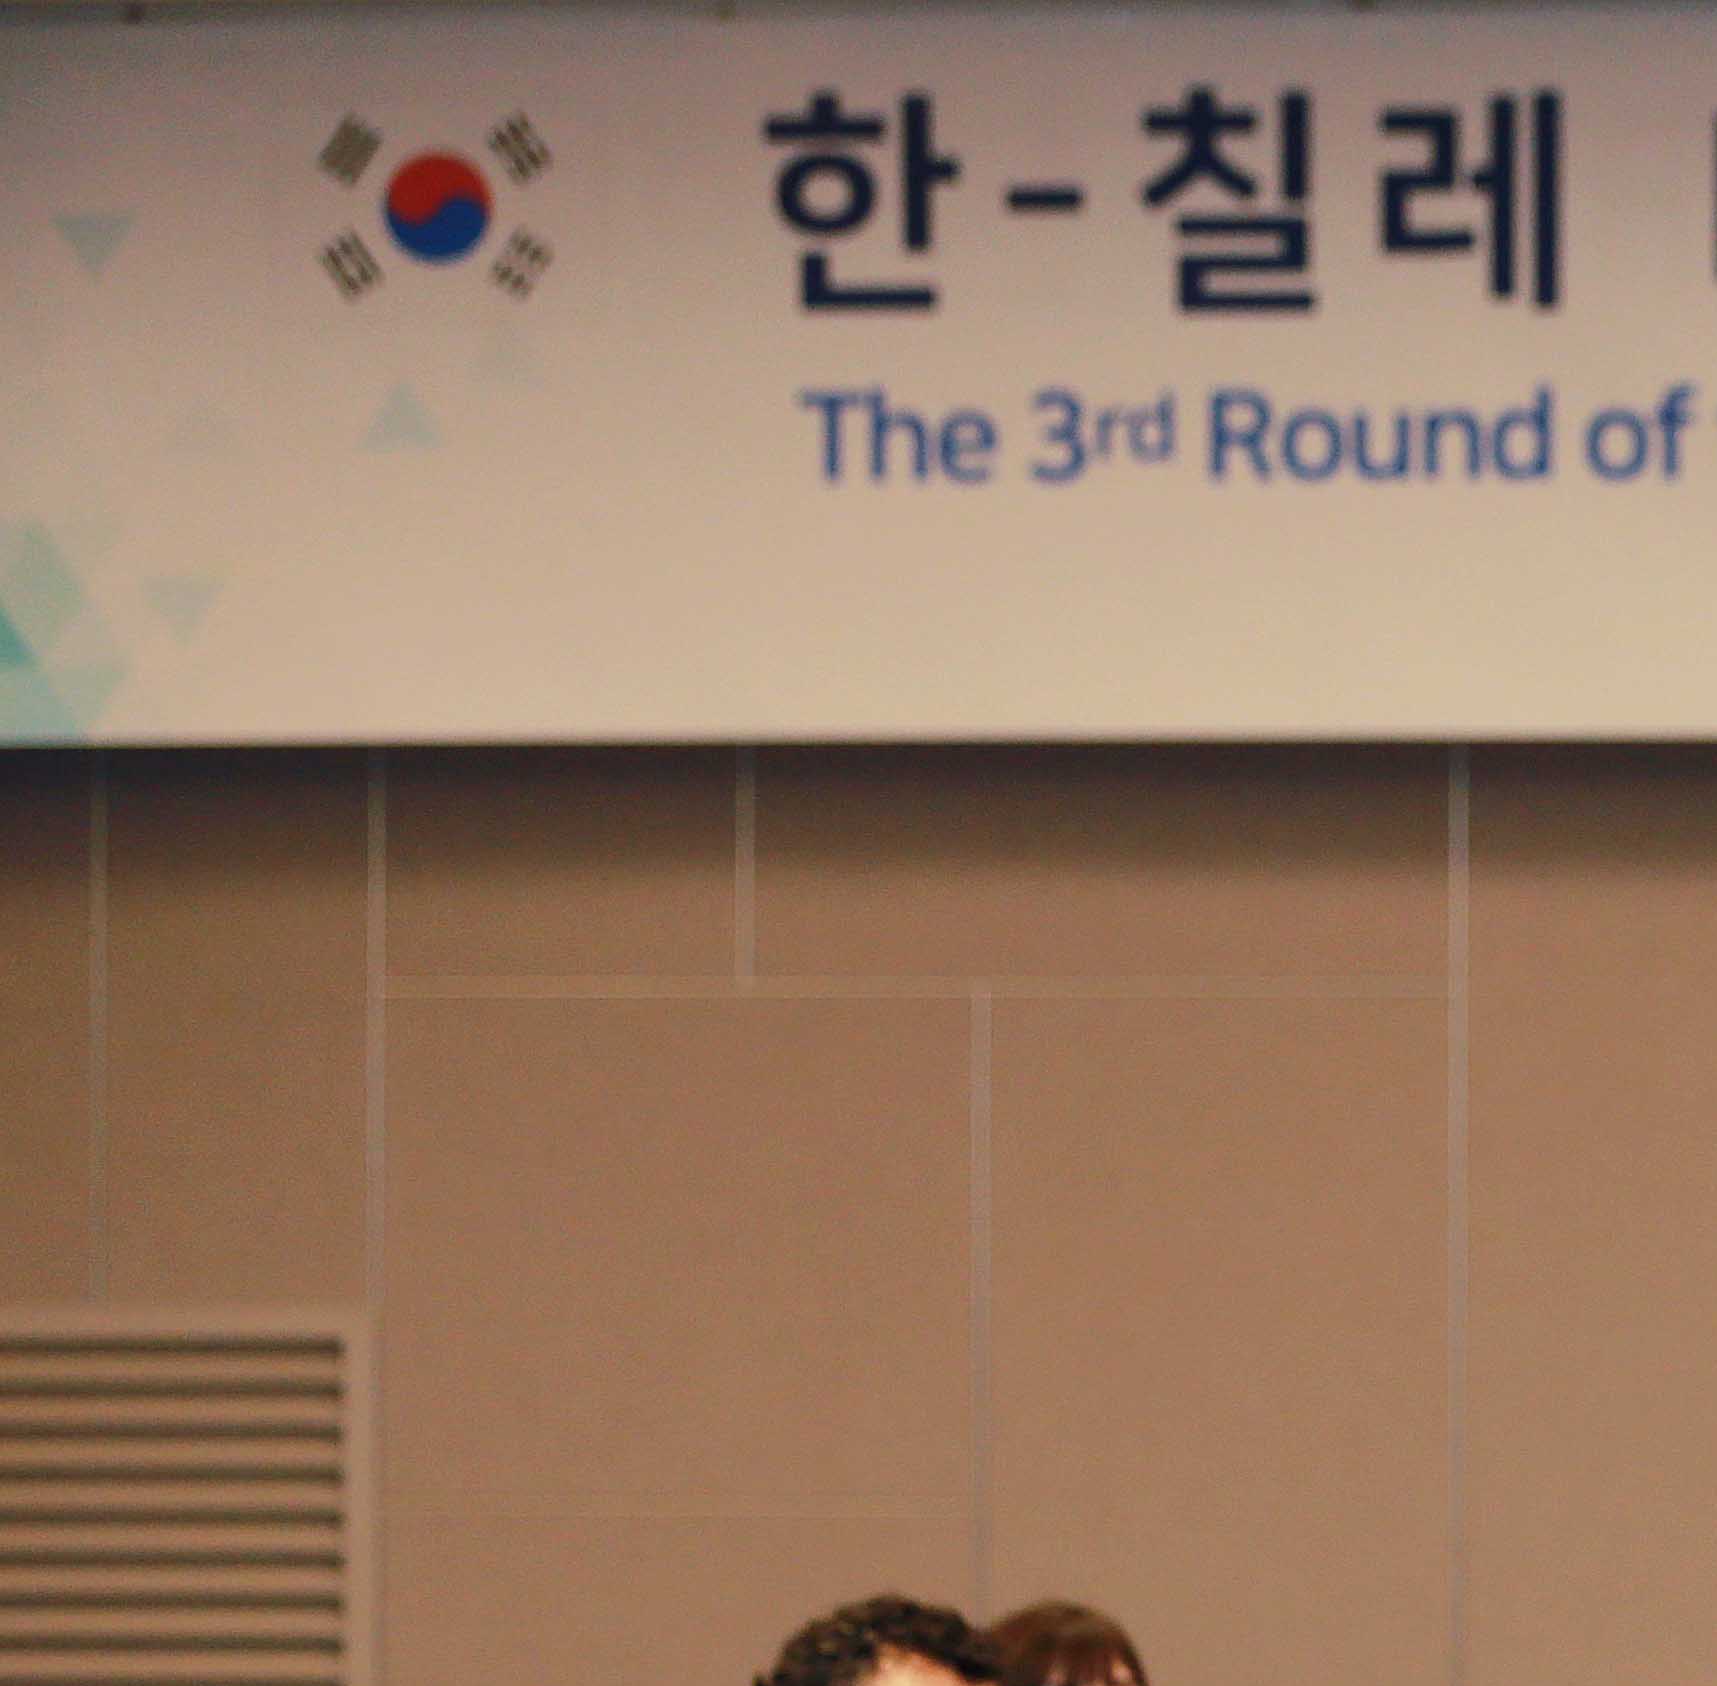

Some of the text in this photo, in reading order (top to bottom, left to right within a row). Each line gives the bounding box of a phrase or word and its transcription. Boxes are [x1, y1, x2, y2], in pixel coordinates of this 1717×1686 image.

[801, 388, 997, 481] The
[1030, 386, 1175, 484] 3rd
[1208, 387, 1554, 481] Round
[1584, 383, 1695, 480] of
